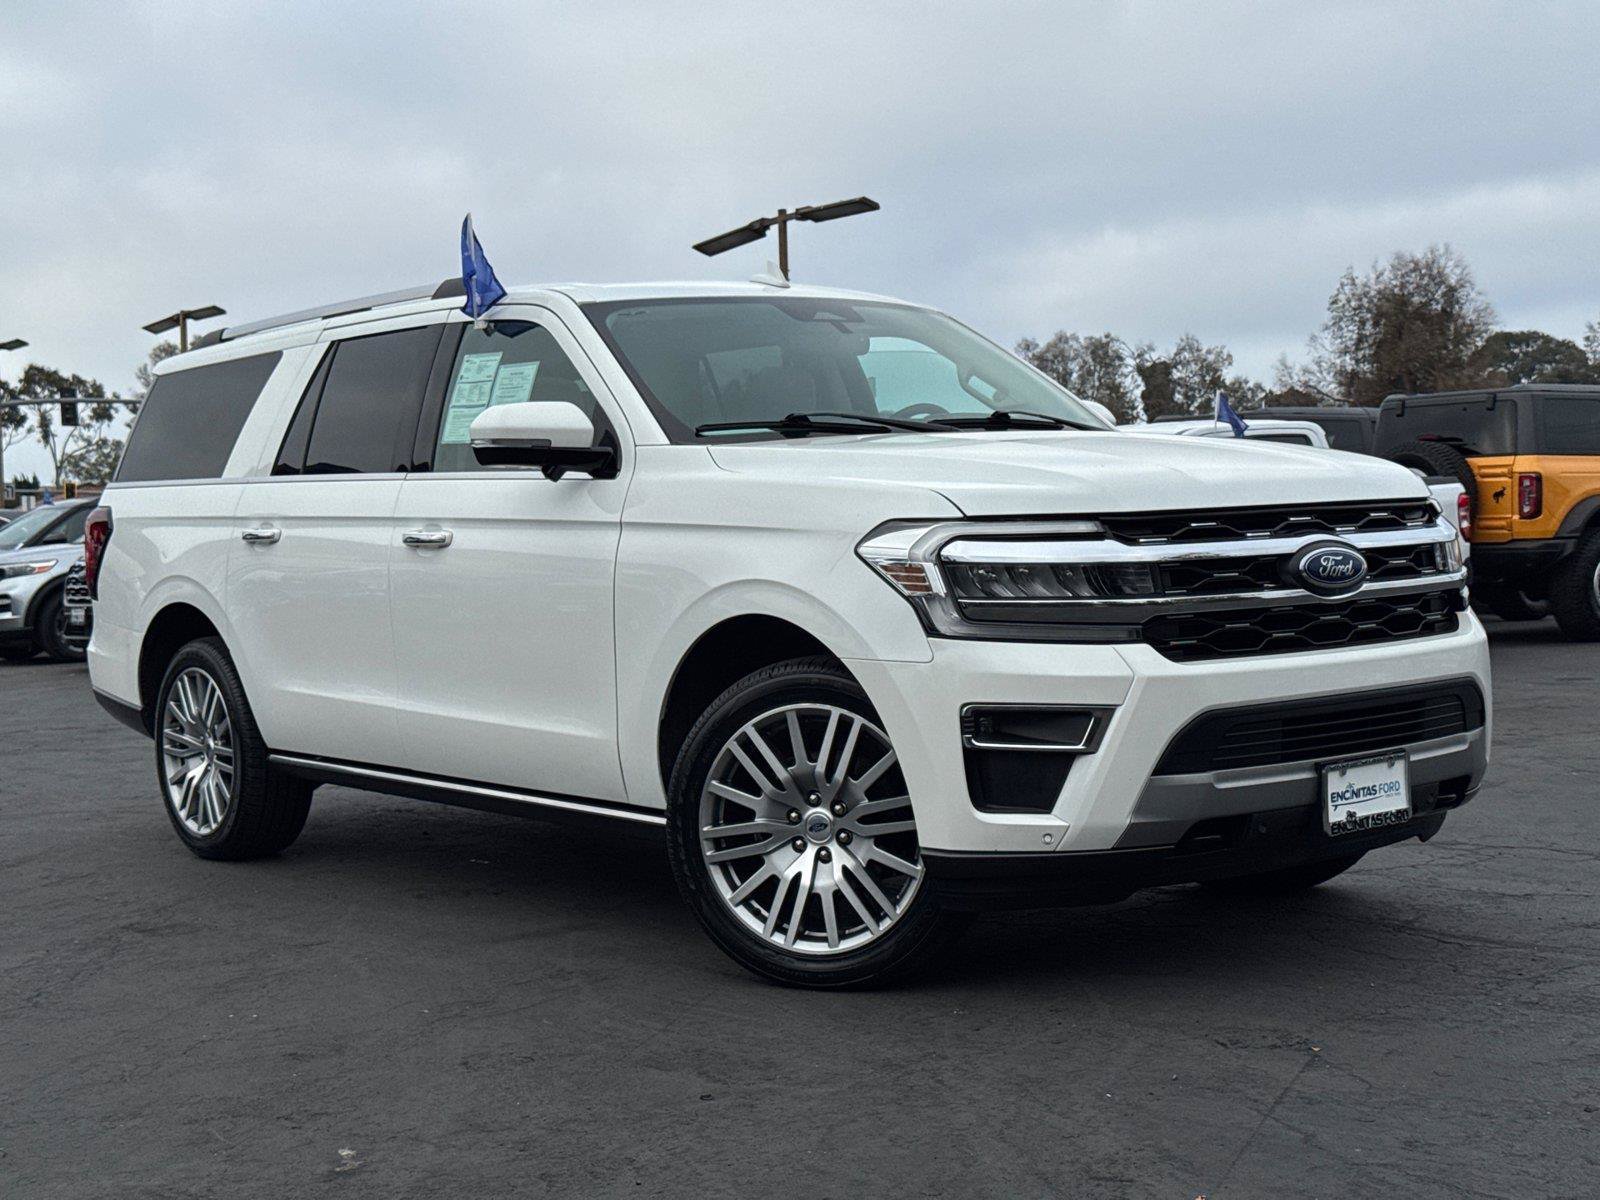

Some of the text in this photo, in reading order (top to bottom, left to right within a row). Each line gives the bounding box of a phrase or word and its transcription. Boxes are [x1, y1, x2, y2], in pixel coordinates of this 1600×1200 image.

[1319, 555, 1355, 577] Ford
[1331, 781, 1400, 803] ENCINITAS FORD
